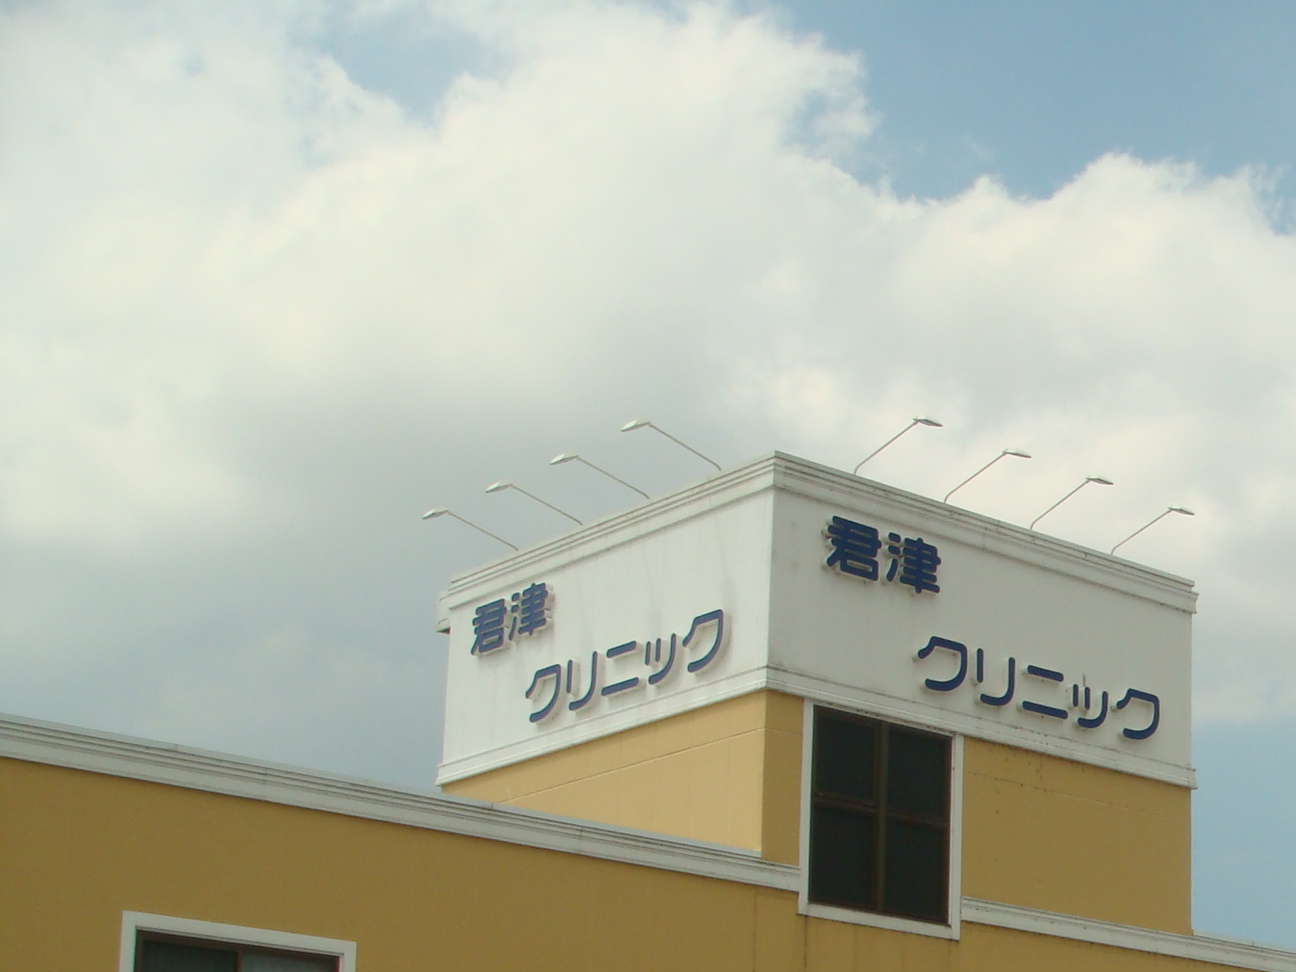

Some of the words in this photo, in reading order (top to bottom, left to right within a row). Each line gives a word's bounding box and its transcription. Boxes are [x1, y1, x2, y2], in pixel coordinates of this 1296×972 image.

[826, 515, 942, 595] 君津
[471, 582, 549, 654] 君津
[525, 608, 724, 723] クリニック
[917, 636, 1161, 740] クリニック
